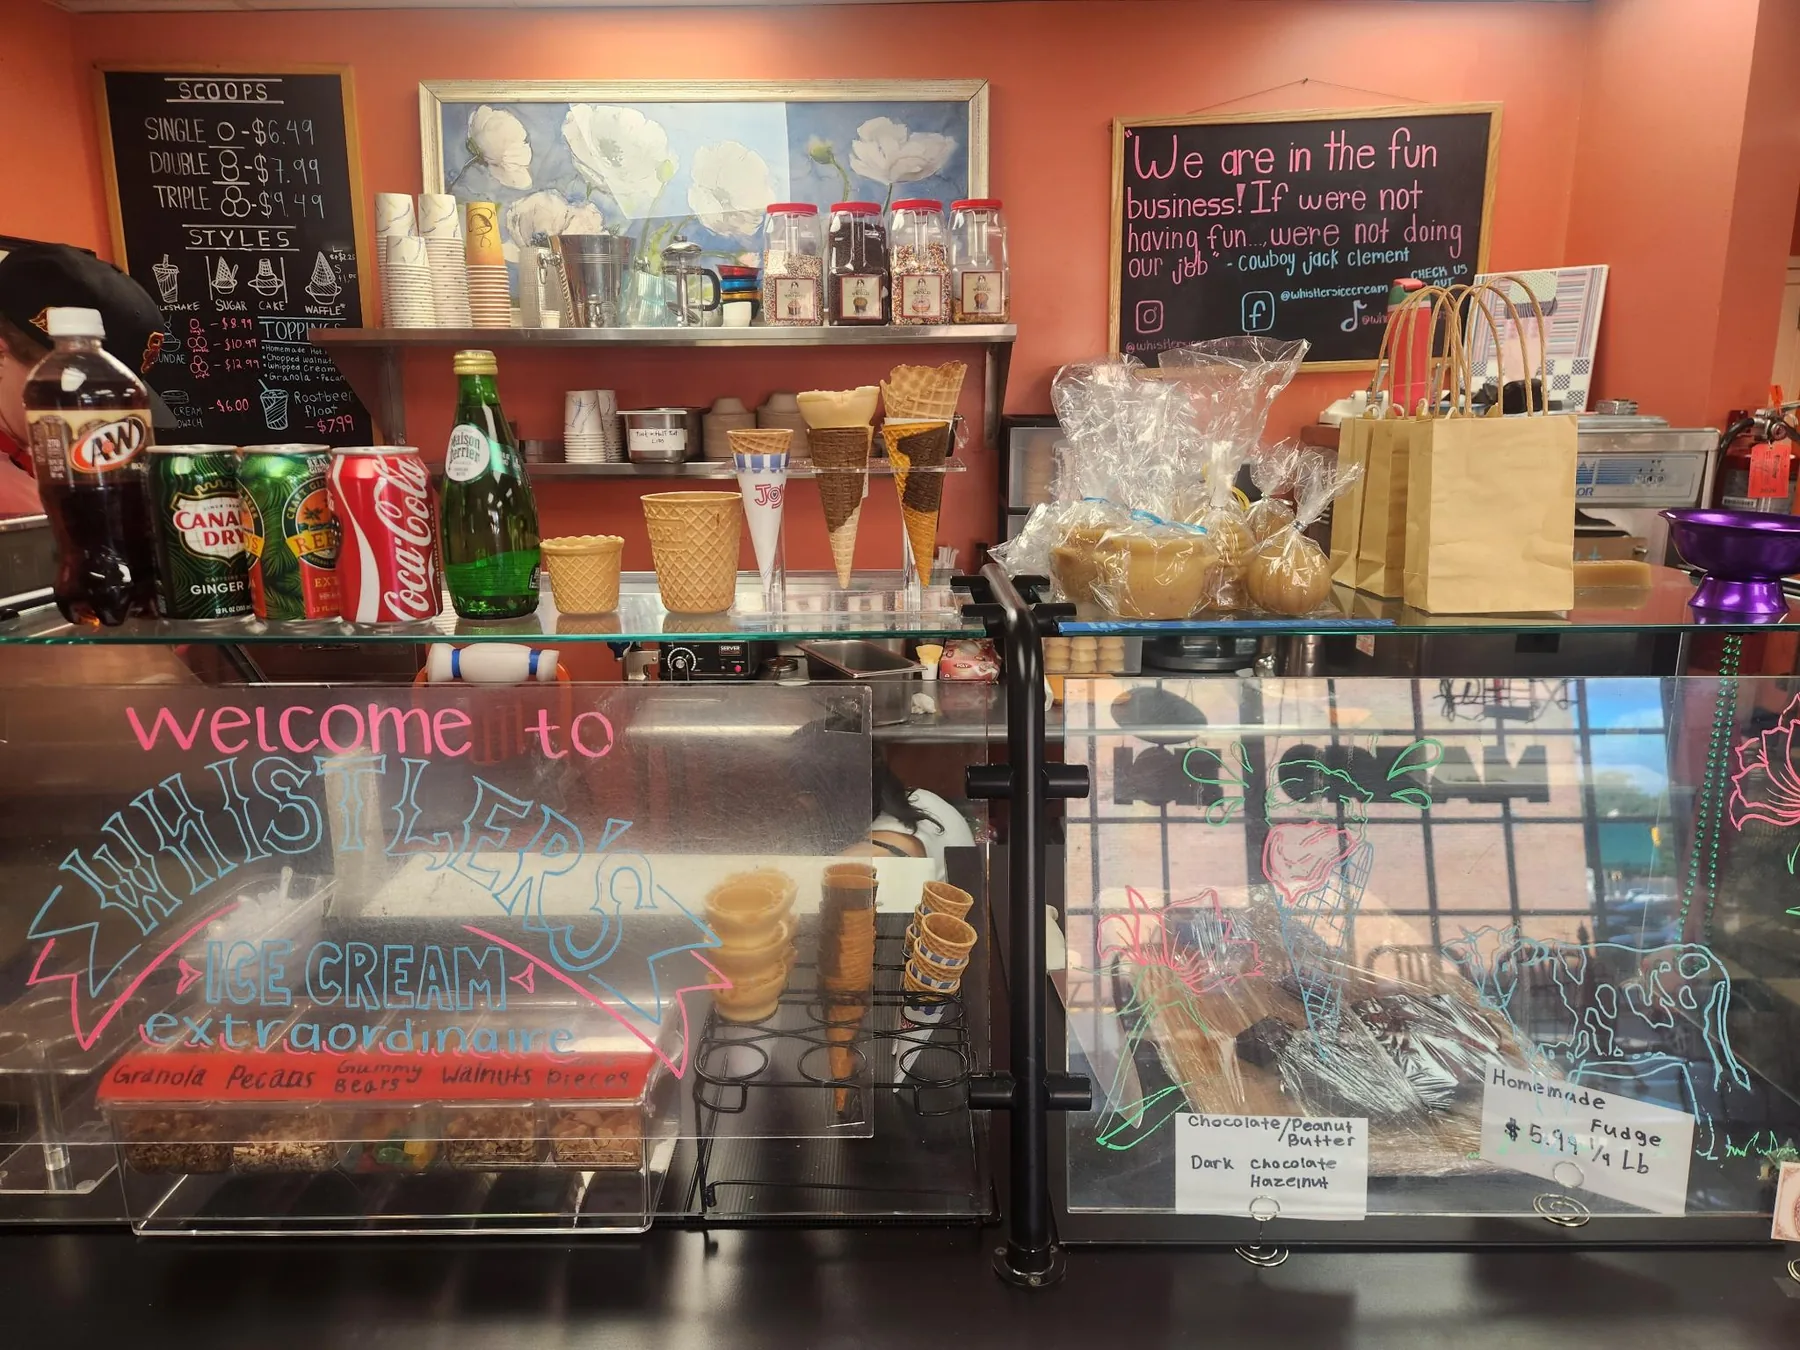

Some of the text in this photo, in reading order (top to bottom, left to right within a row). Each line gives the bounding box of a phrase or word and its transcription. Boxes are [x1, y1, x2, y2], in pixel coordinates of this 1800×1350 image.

[178, 82, 269, 101] SCOOPS
[144, 117, 206, 144] SINGLE
[1220, 146, 1274, 177] are
[1288, 142, 1311, 174] in
[1323, 129, 1376, 171] the
[1387, 127, 1437, 170] fun
[150, 151, 211, 175] DOUBLE
[152, 185, 212, 211] TRIPLE
[1127, 183, 1247, 219] business!
[1250, 179, 1289, 214] If
[1379, 179, 1424, 211] not
[188, 229, 291, 248] STYLES
[1127, 223, 1198, 262] having
[1354, 217, 1390, 245] not
[1403, 213, 1462, 259] doing
[1128, 257, 1164, 279] our
[1302, 249, 1339, 276] jack
[1347, 247, 1410, 267] clement
[1411, 264, 1468, 280] CHECK US
[157, 301, 200, 311] LKSHAKE
[215, 299, 248, 312] SUGAR
[258, 300, 285, 311] CAKE
[259, 321, 341, 341] TOPPI
[265, 345, 306, 354] Homemade
[266, 354, 301, 364] Chopped
[158, 354, 186, 365] UNDAE
[303, 364, 336, 373] Cream
[269, 372, 312, 382] Granola
[173, 406, 203, 417] CREAM
[305, 404, 338, 418] float
[175, 510, 243, 531] CANA
[190, 580, 244, 595] GINGER
[125, 703, 614, 759] welcome to
[205, 940, 507, 1011] ICE CREAM
[143, 1012, 576, 1056] extraordinaire
[113, 1064, 208, 1087] Granola
[337, 1059, 423, 1083] Gummy
[441, 1062, 532, 1085] Walnuts
[334, 1078, 400, 1094] Bears
[1492, 1067, 1606, 1110] Homemade
[1288, 1133, 1356, 1148] Butter
[1589, 1118, 1662, 1147] Fudge
[1191, 1154, 1235, 1170] Dark
[1622, 1149, 1650, 1175] Lb
[1250, 1174, 1329, 1190] Hazelnut
